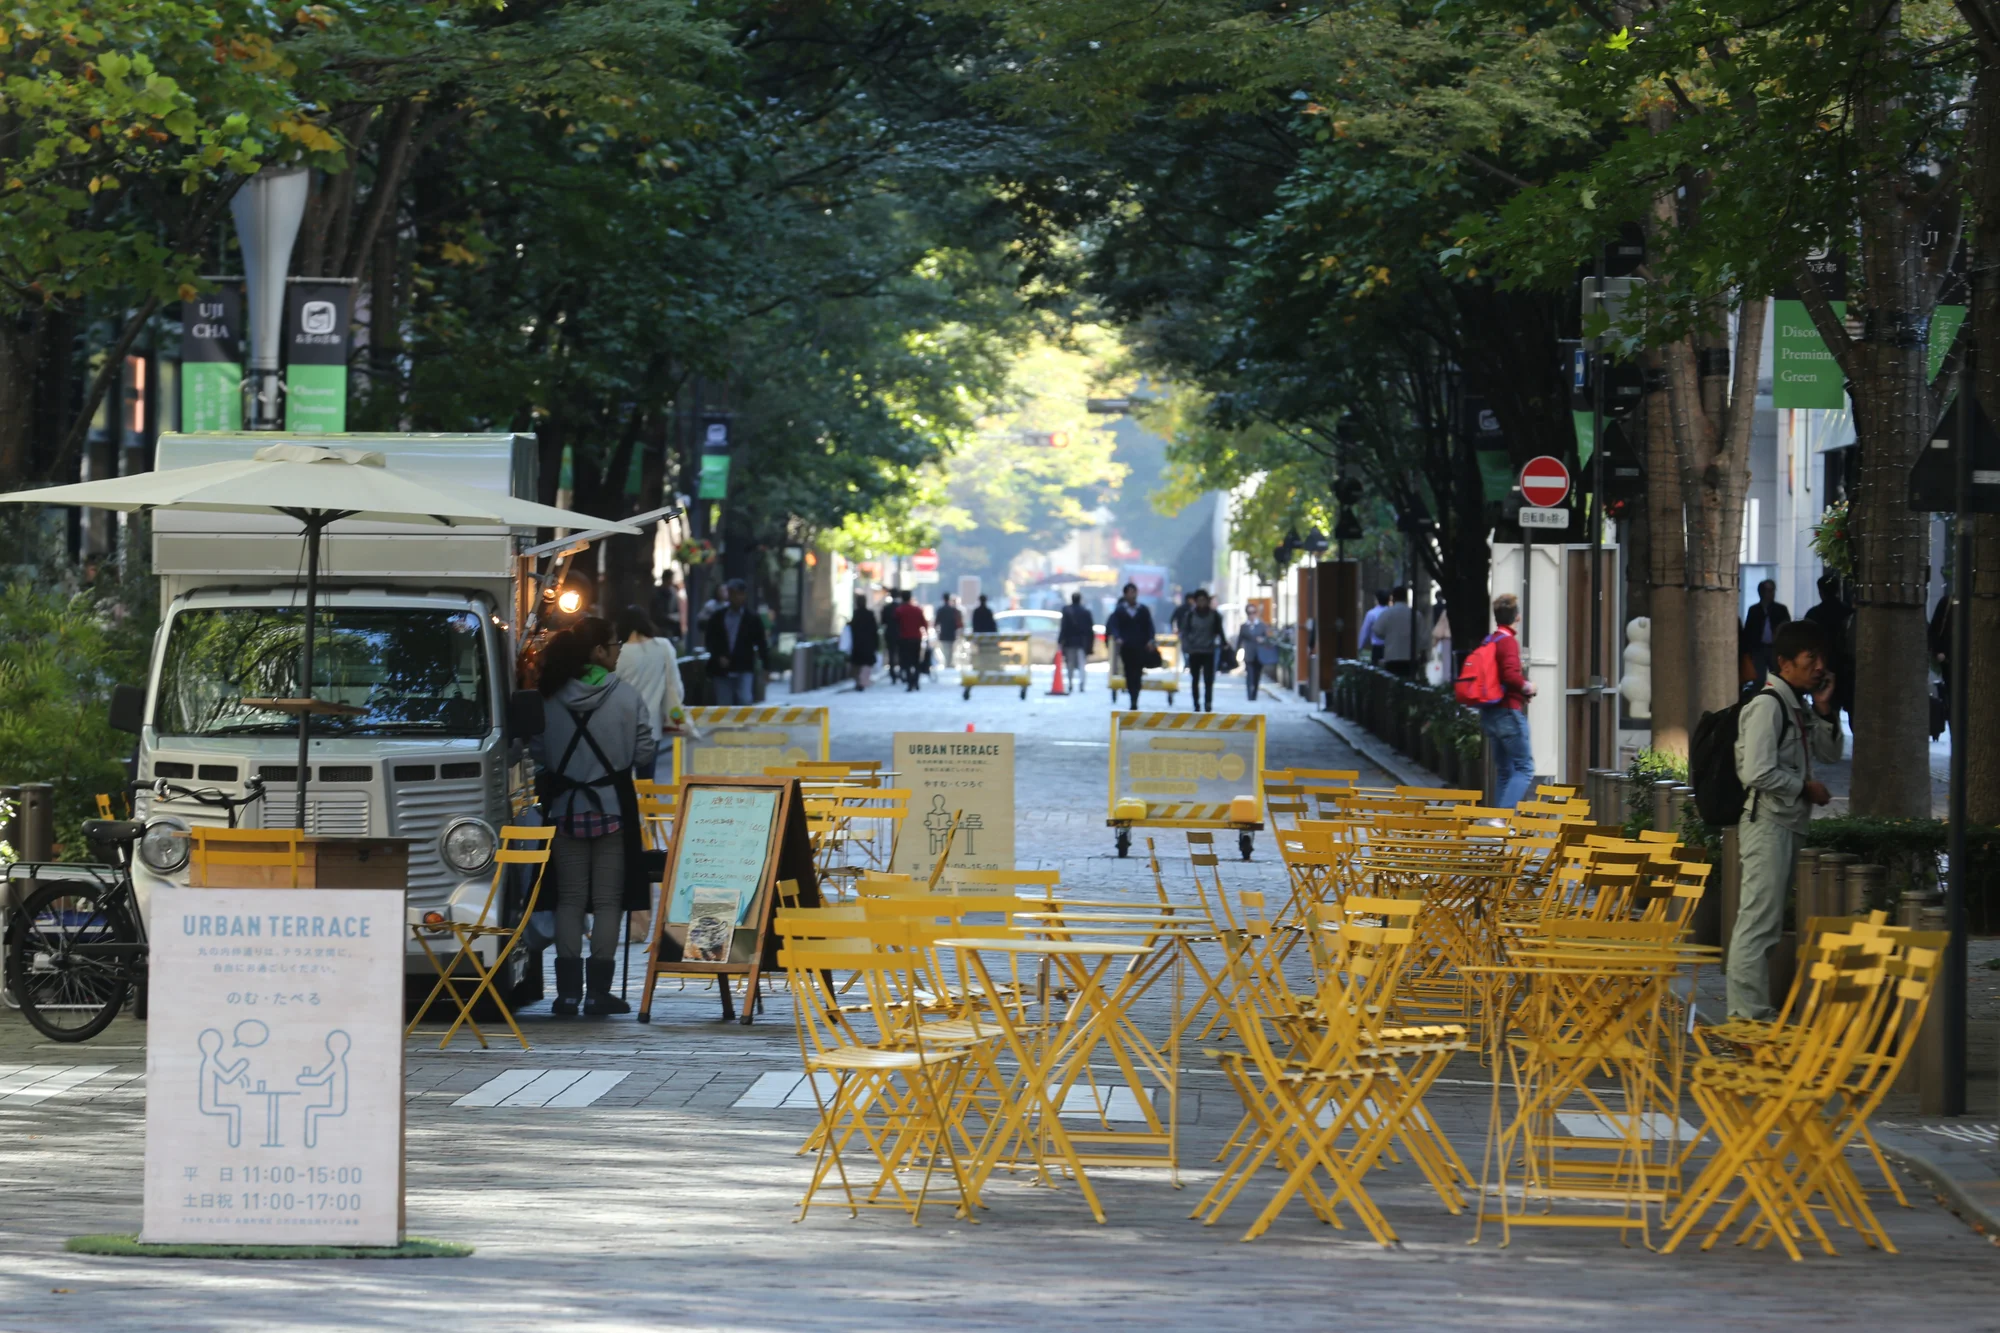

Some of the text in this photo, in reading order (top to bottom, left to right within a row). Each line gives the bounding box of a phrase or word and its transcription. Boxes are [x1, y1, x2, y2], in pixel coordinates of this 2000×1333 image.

[199, 303, 223, 319] UJI
[191, 323, 229, 338] CHA
[1780, 369, 1817, 382] Green
[909, 744, 1000, 756] URBAN TERRACE
[183, 915, 371, 938] URBAN TERRACE
[226, 991, 322, 1006] のむ・たべる
[243, 1166, 363, 1184] 11:00-15:00
[183, 1193, 362, 1211] 土日祝 11:00-17:00
